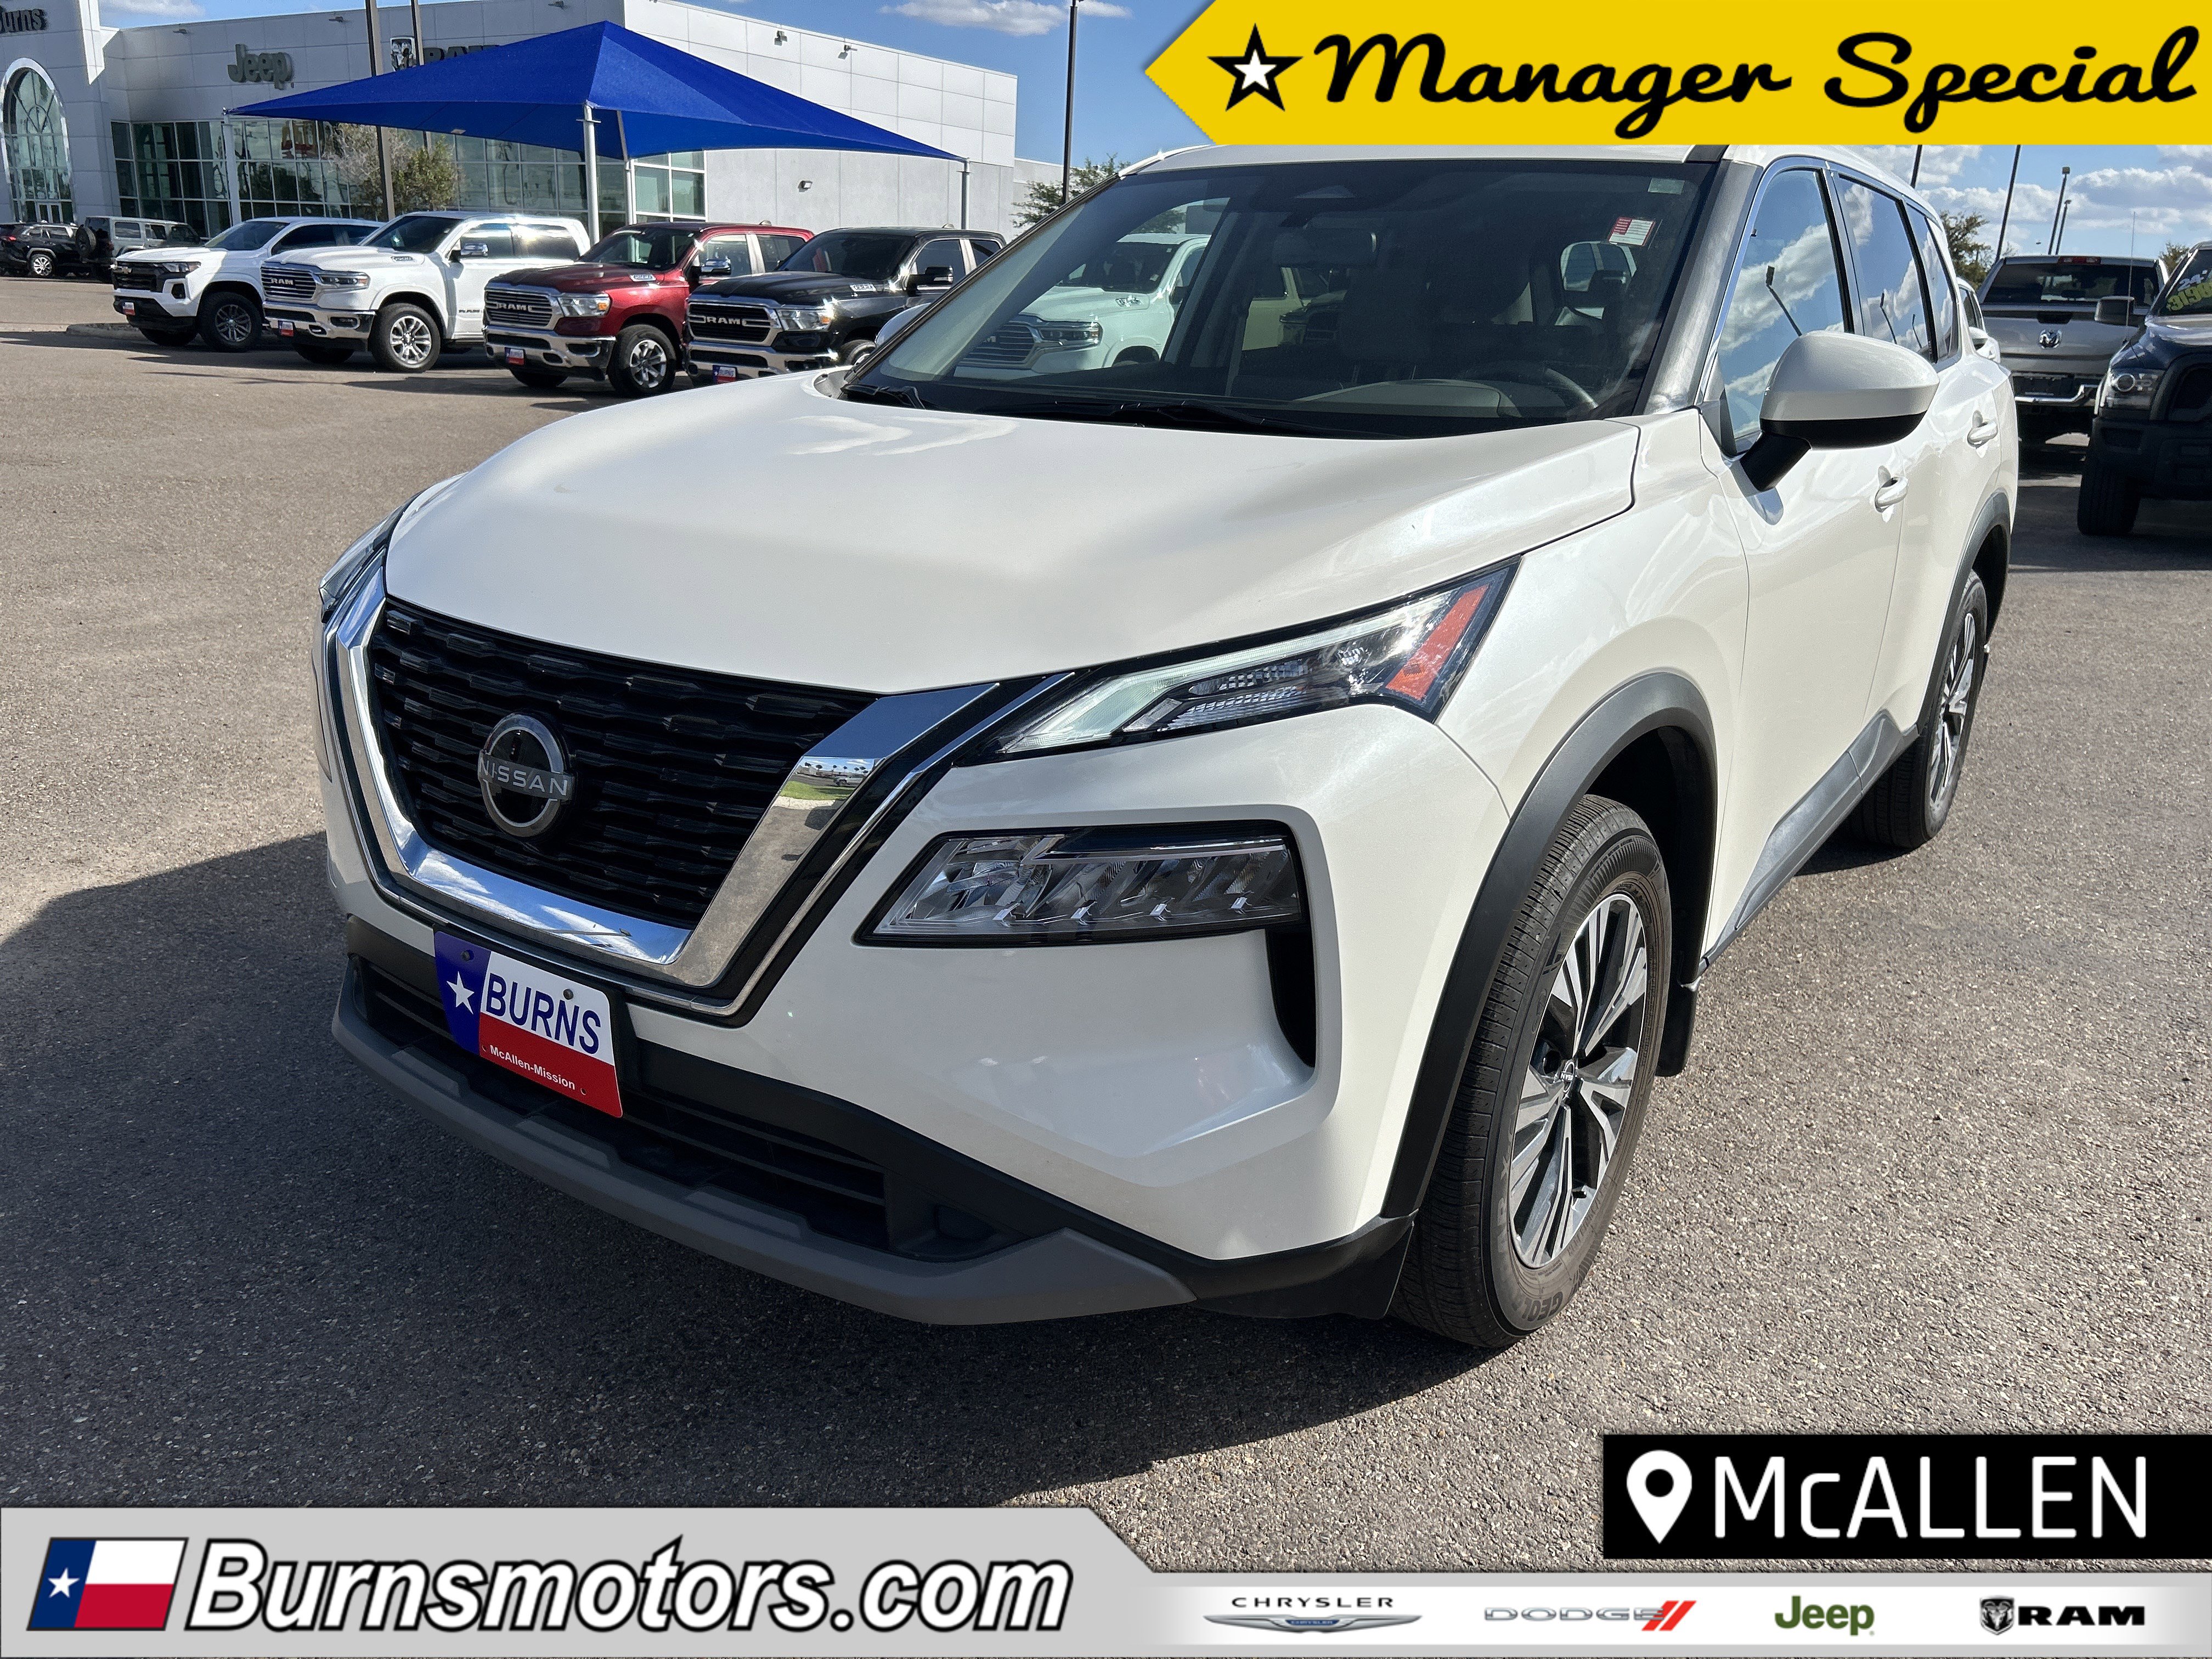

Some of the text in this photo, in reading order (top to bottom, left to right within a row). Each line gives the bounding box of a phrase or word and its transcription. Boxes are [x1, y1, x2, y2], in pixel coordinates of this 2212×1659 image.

[0, 6, 42, 33] urns
[227, 44, 292, 90] Jeep
[706, 317, 741, 325] RAM
[479, 757, 568, 796] NISSAN
[486, 973, 602, 1054] BURNS
[489, 1044, 575, 1091] McAllen-Mission
